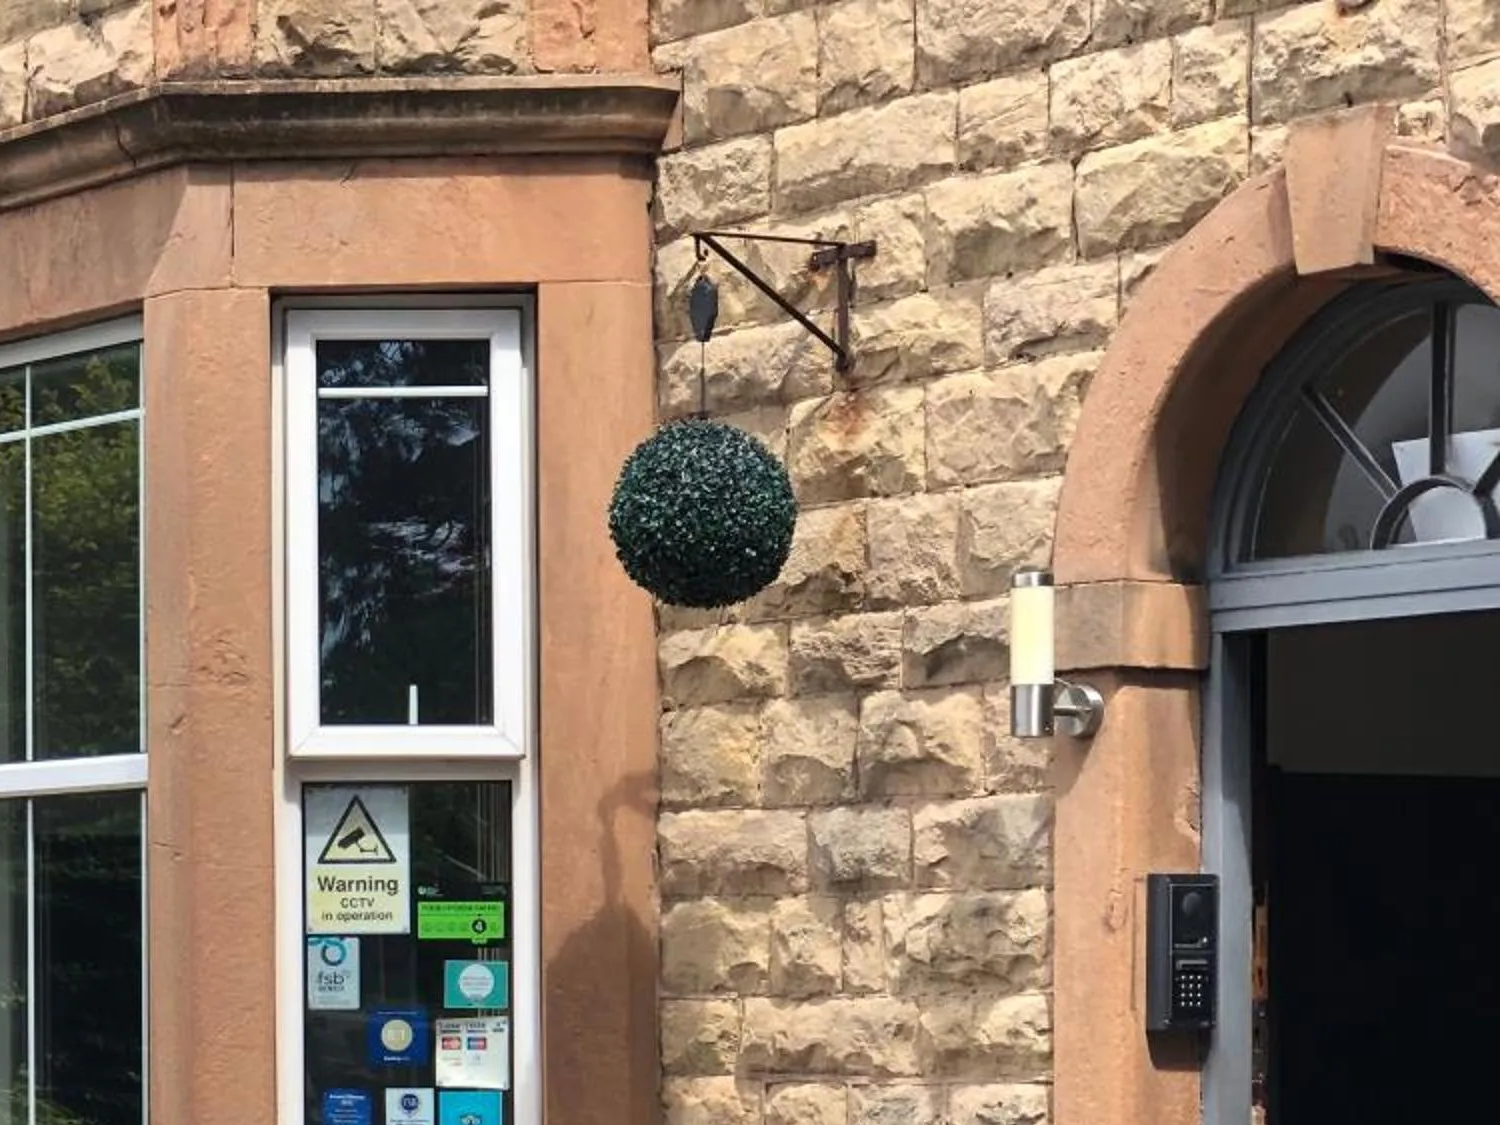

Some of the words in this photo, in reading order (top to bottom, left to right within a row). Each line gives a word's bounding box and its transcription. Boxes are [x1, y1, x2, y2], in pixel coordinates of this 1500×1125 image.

[317, 875, 398, 896] Warning
[340, 897, 375, 908] CCTV
[321, 911, 333, 920] in
[336, 911, 393, 922] operation
